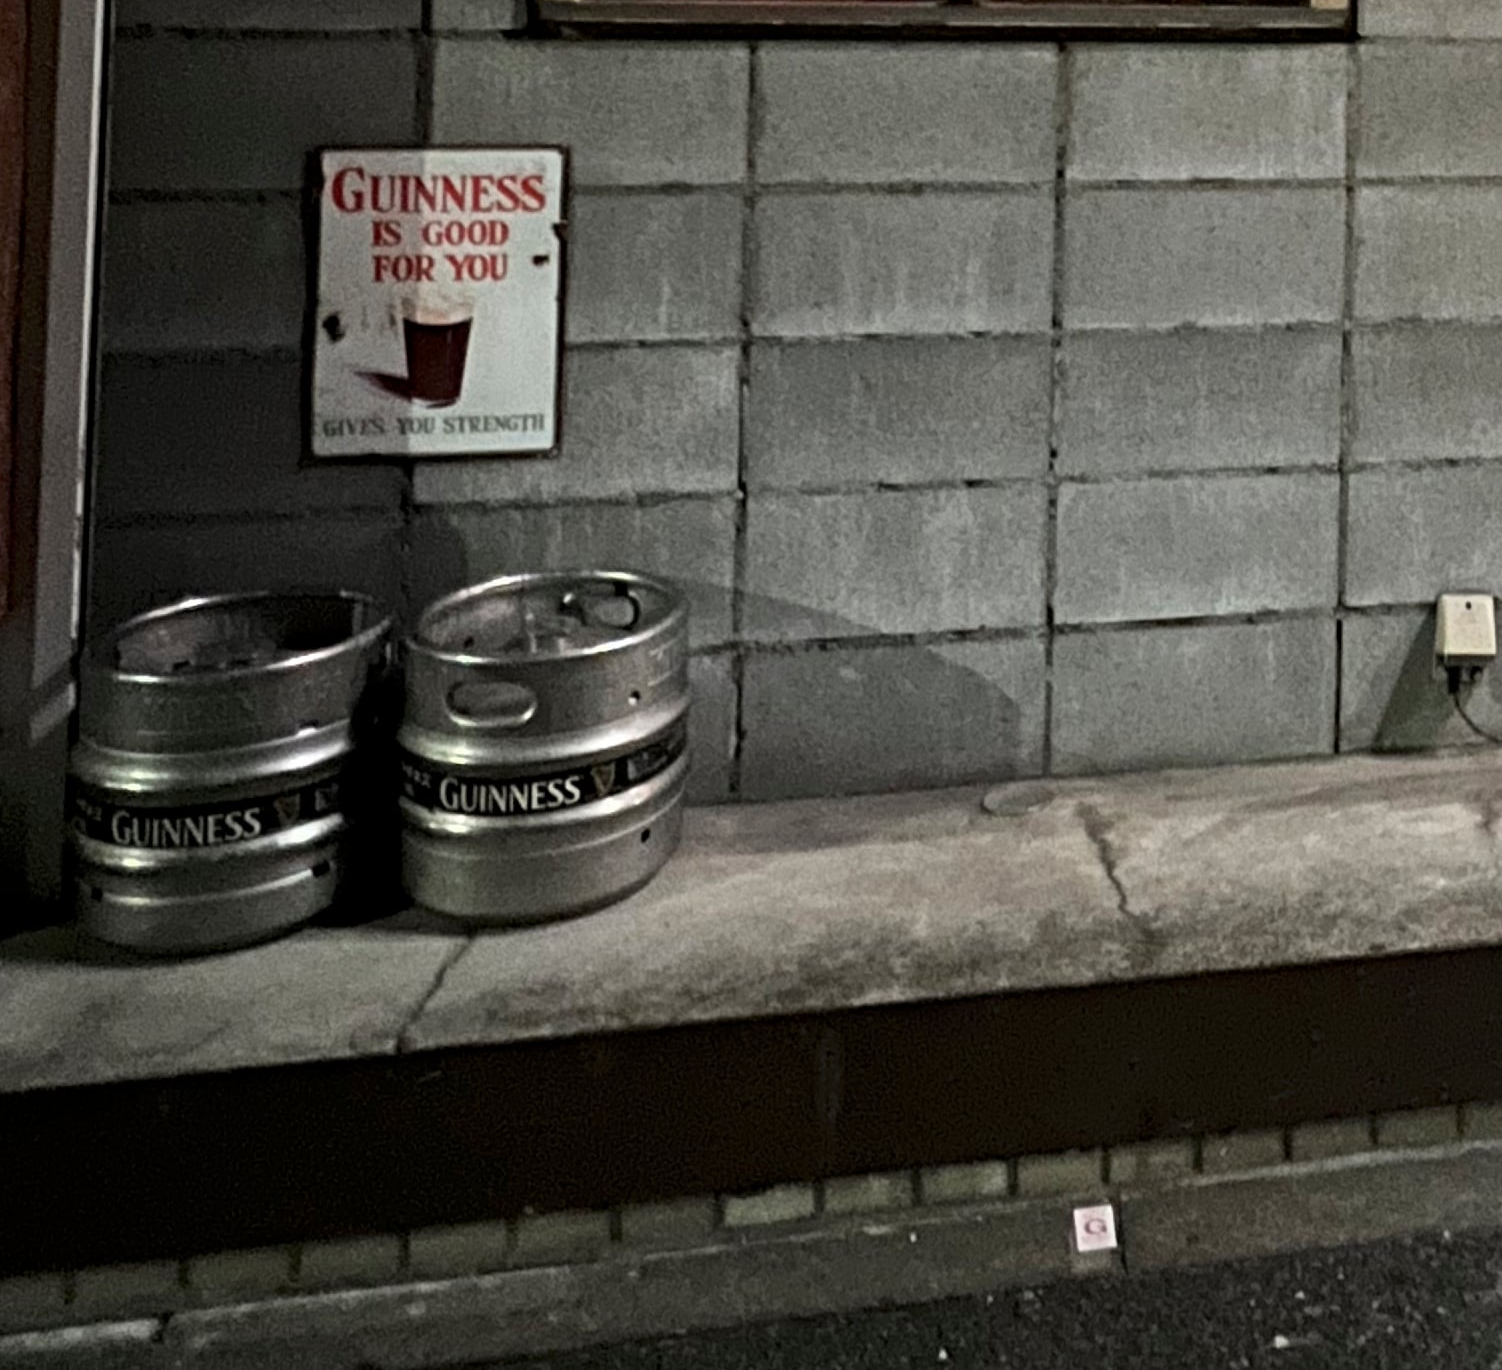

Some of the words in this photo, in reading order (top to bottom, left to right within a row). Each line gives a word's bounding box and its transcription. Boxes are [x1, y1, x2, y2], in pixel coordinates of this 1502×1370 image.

[331, 167, 546, 214] GUINNESS
[371, 220, 402, 247] IS
[421, 219, 510, 247] GOOD
[371, 254, 436, 283] FOR
[445, 253, 509, 282] YOU
[322, 417, 386, 437] GIVES
[397, 416, 436, 436] YOU
[442, 413, 545, 435] STRENGTH
[439, 776, 582, 813] GUINNESS
[111, 807, 262, 847] GUINNESS
